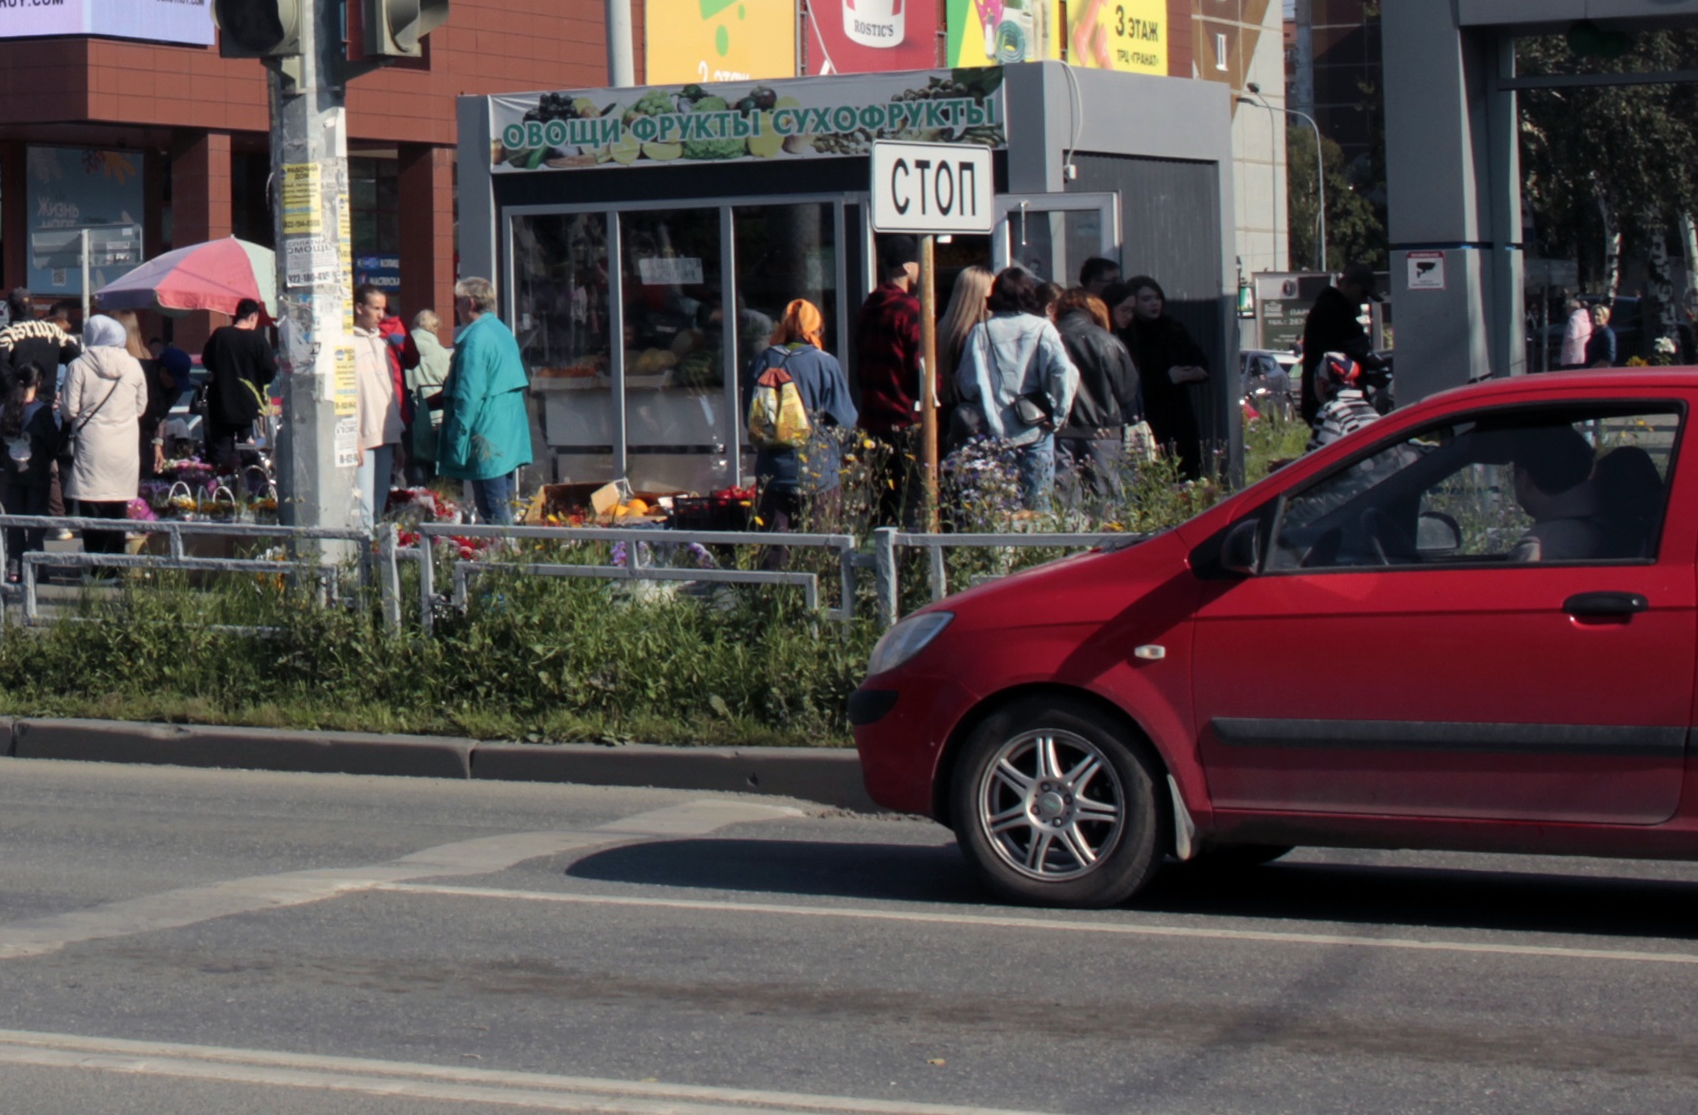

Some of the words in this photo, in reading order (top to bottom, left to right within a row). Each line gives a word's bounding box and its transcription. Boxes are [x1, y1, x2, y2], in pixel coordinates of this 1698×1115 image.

[854, 19, 894, 37] ROSTIC'S
[1115, 4, 1125, 37] 3
[1128, 17, 1159, 42] ЭТАЖ
[1117, 49, 1129, 66] ТРЦ
[503, 118, 620, 150] ОВОЩИ
[632, 109, 761, 141] ФРУКТЫ
[772, 97, 995, 136] СУХОФРУКТЫ
[891, 158, 978, 216] СТОП
